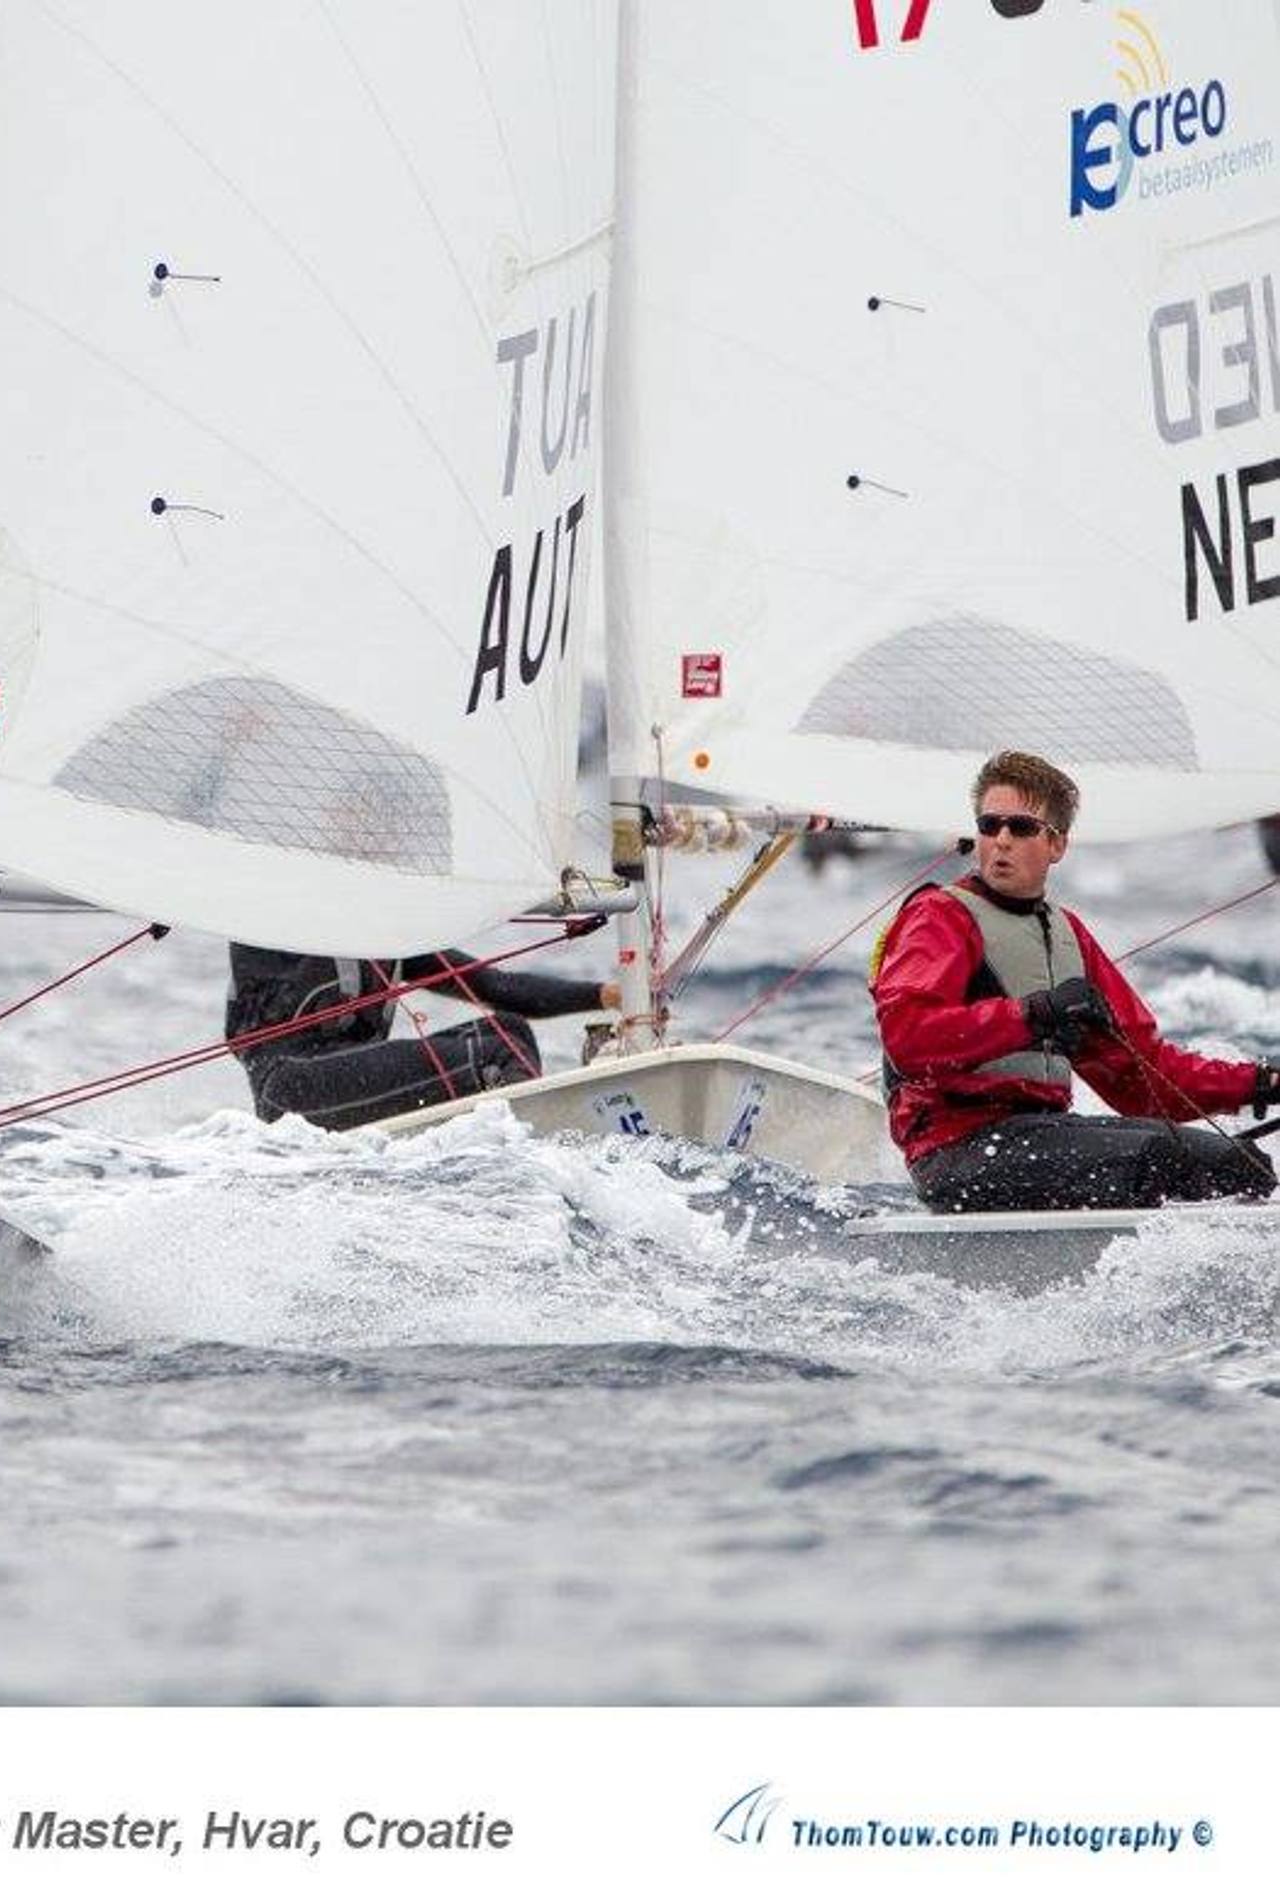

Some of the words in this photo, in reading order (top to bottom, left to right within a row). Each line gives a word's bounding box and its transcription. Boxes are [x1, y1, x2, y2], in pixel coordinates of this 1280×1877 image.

[1128, 80, 1226, 157] creo
[1138, 141, 1274, 200] betaalsystemen
[466, 494, 586, 715] AUT
